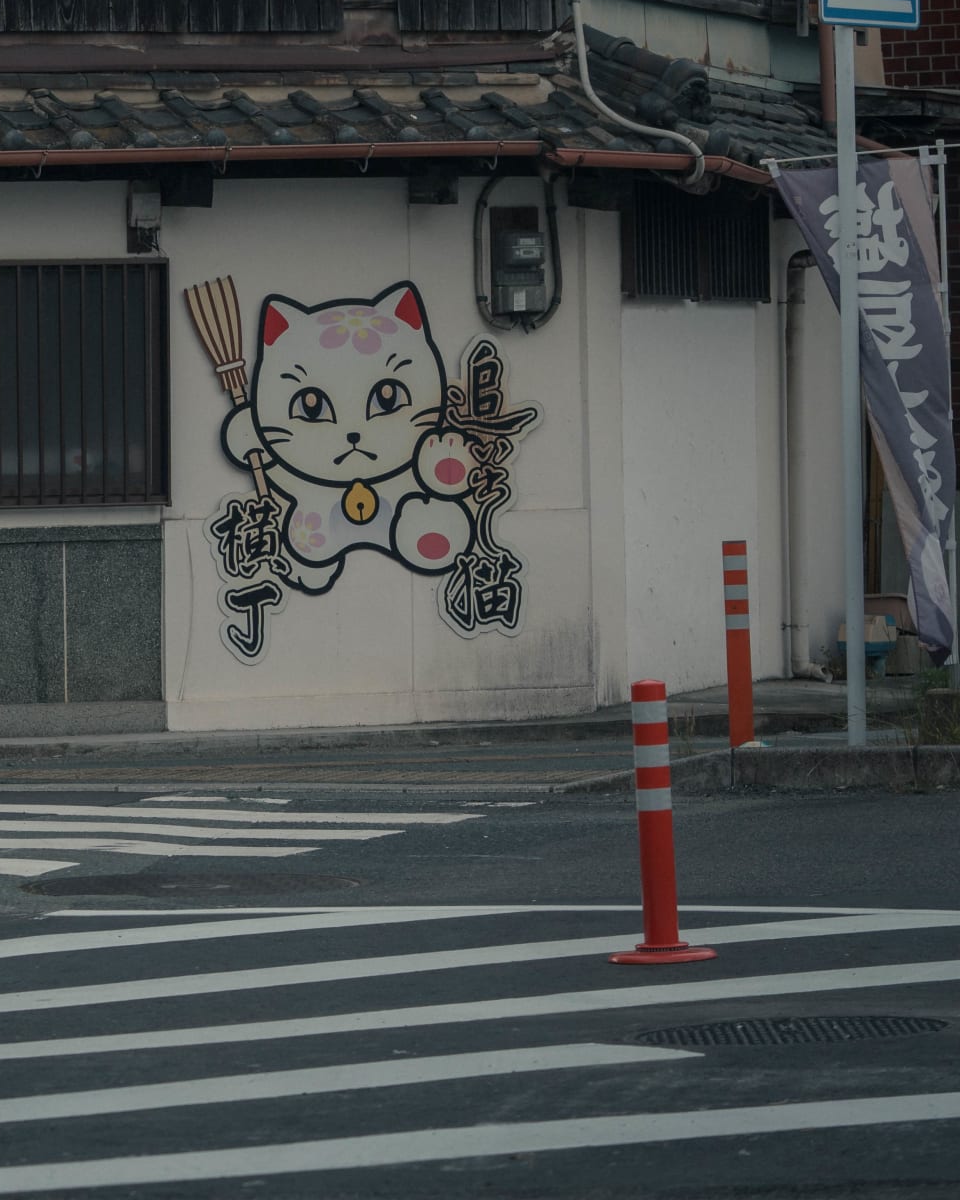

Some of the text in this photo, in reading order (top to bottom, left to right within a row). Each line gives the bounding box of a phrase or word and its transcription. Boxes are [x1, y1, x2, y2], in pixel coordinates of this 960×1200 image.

[211, 498, 293, 657] 横丁
[446, 340, 537, 631] 追い出し猫
